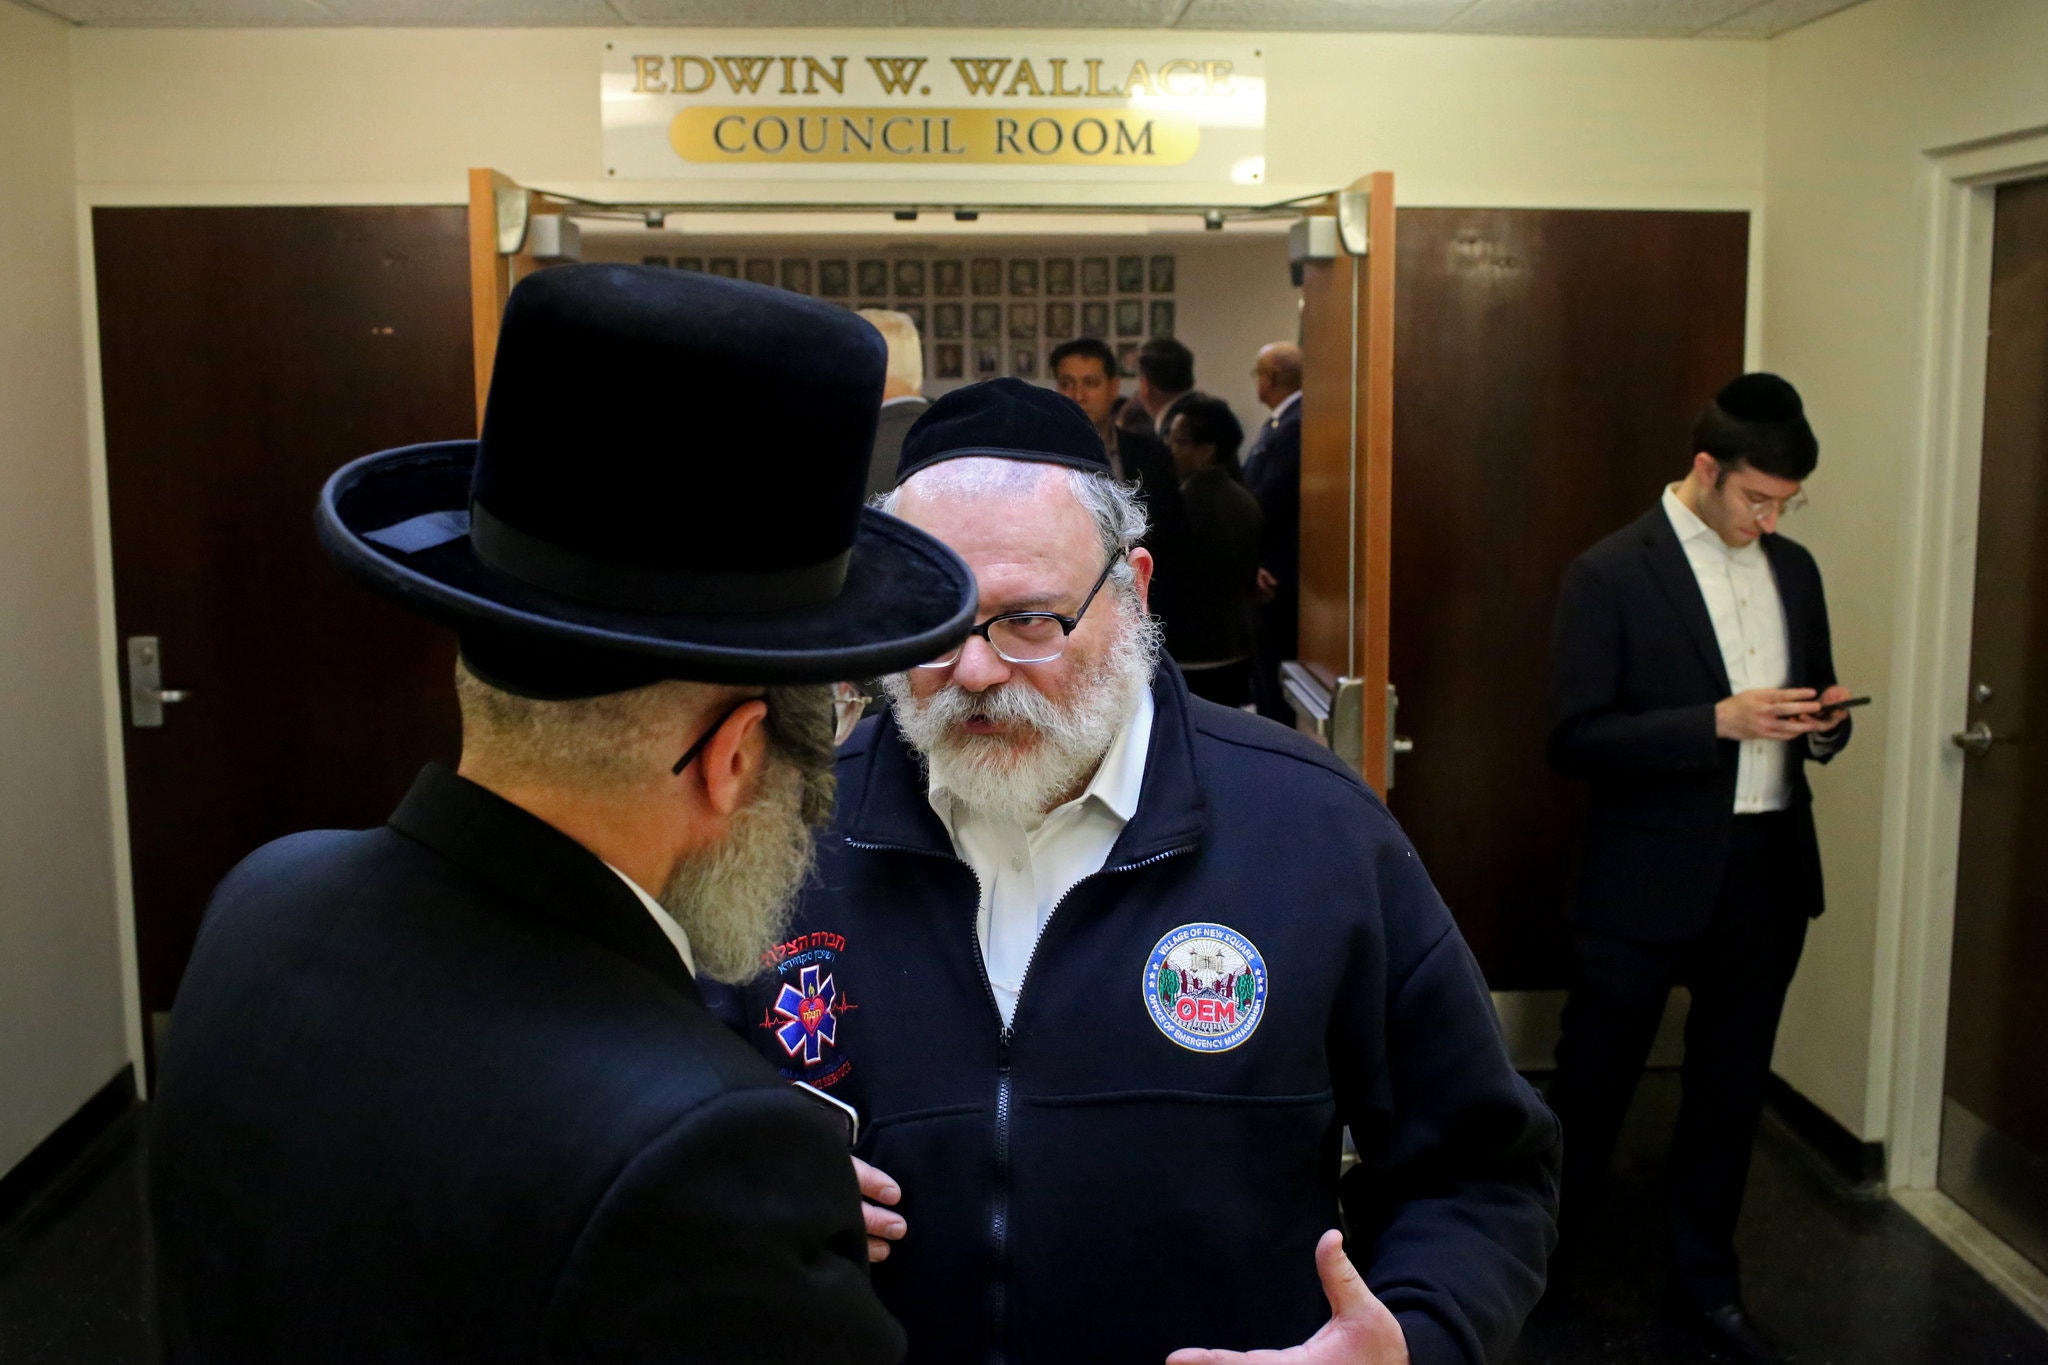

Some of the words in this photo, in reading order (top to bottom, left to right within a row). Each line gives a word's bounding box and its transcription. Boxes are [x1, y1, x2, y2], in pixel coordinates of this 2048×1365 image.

[632, 55, 848, 95] EDWIN
[865, 56, 931, 95] W.
[950, 56, 1235, 97] WALLACE
[713, 115, 966, 154] COUNCIL
[994, 117, 1156, 156] ROOM
[1158, 930, 1189, 956] VILLAGE
[1190, 928, 1203, 938] OF
[1203, 928, 1225, 940] NEW
[1224, 933, 1256, 961] SQUARE
[1149, 994, 1166, 1023] OFFICE
[1163, 1020, 1176, 1033] OF
[1173, 1030, 1223, 1049] EMERGENCY
[1223, 999, 1262, 1046] MANAGEMENT
[1176, 997, 1235, 1024] OEM
